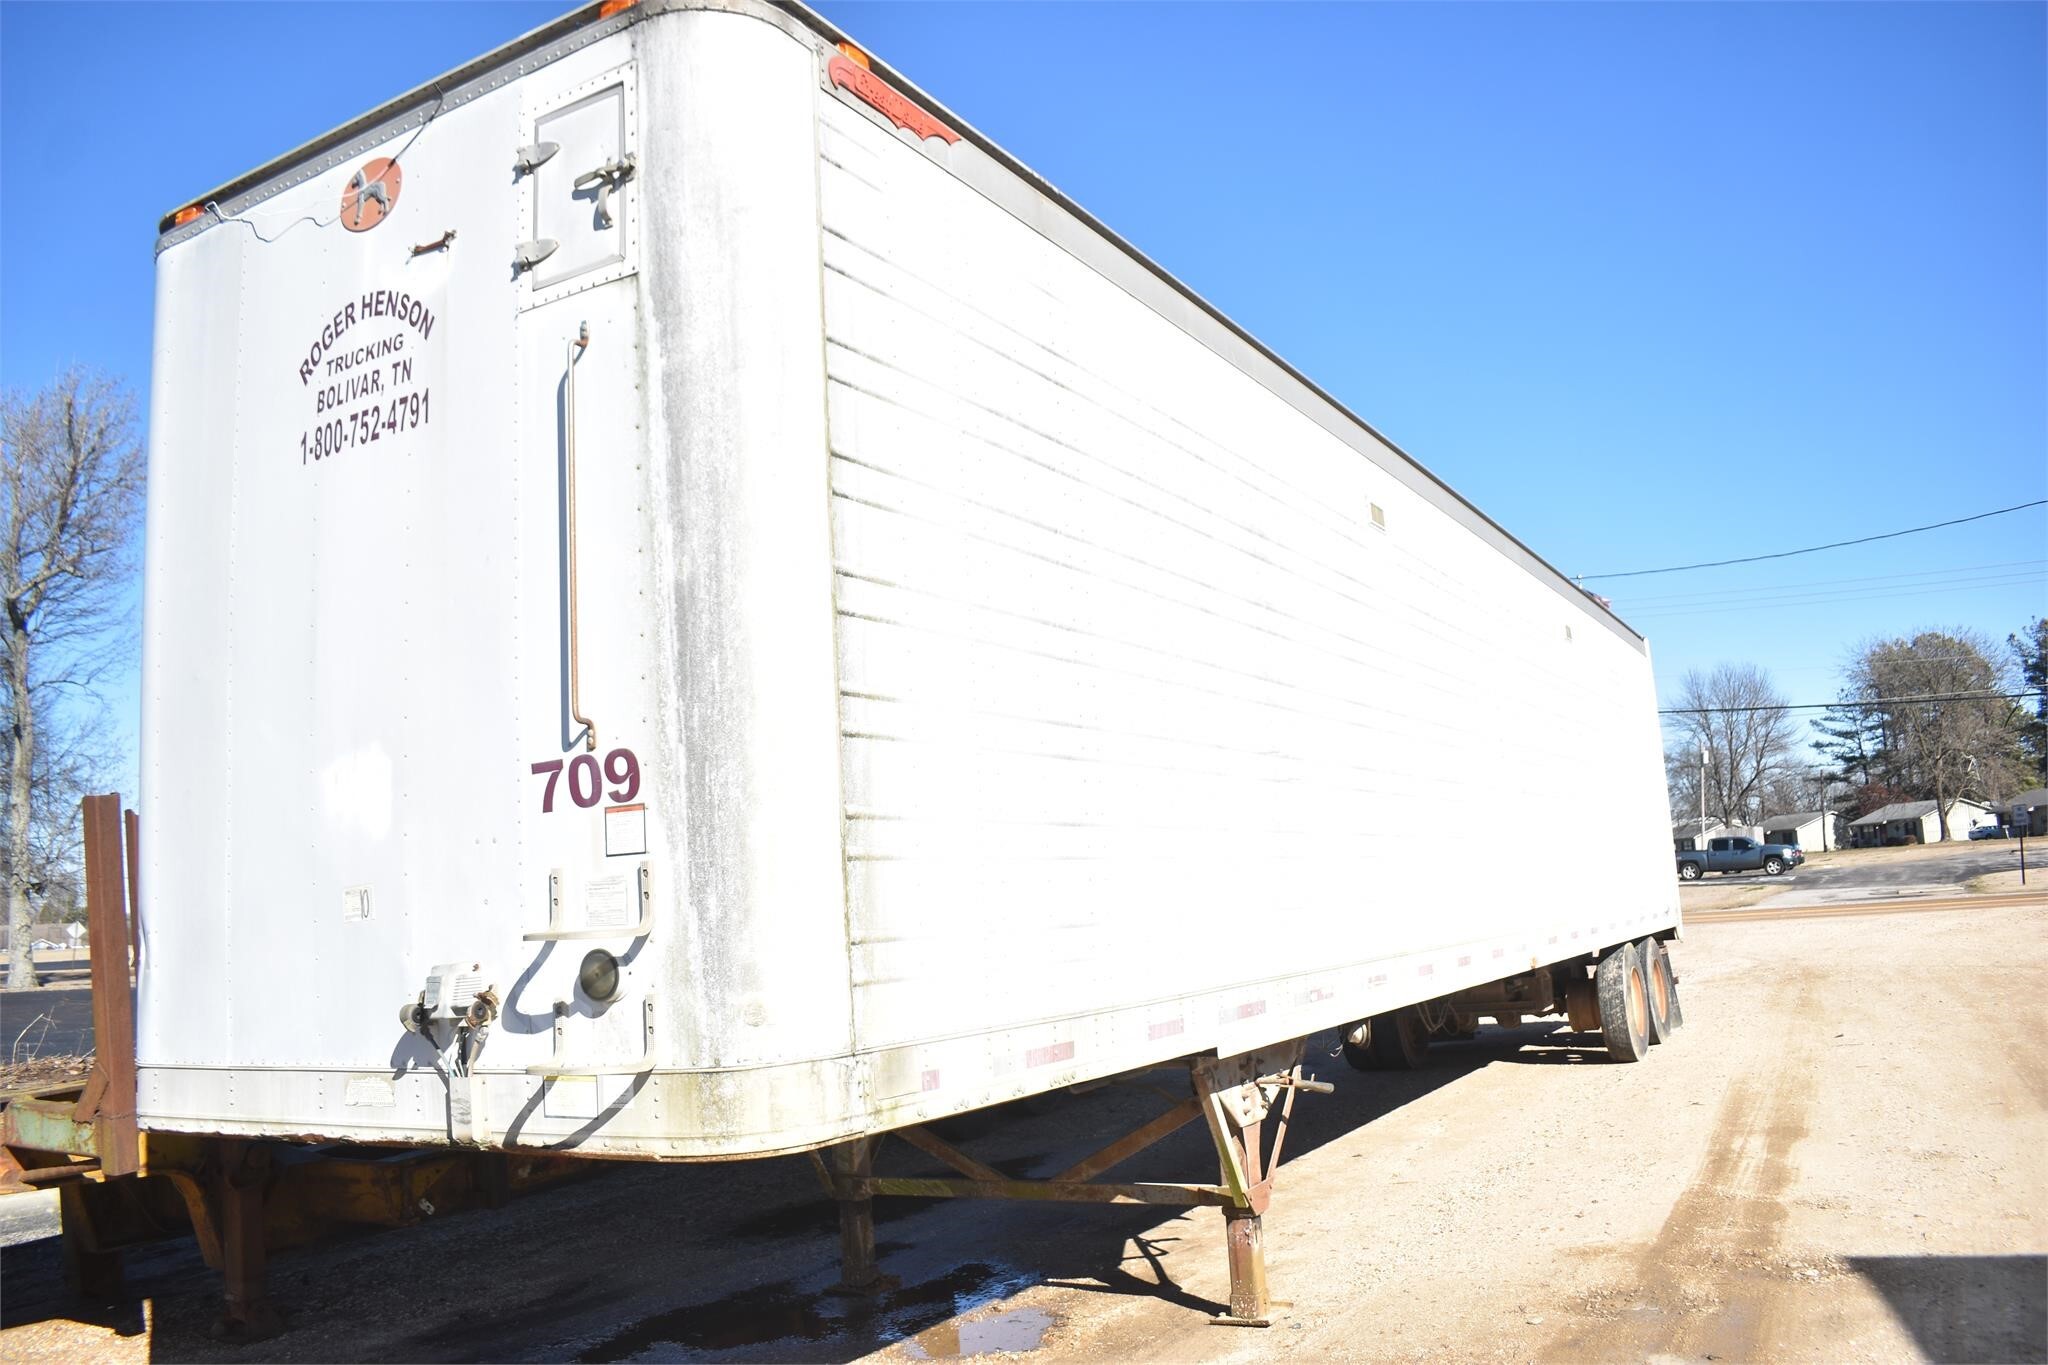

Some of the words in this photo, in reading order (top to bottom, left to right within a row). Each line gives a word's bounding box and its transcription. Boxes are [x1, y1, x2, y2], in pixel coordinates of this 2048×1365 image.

[299, 302, 356, 386] ROGER
[361, 290, 435, 340] HENSON
[326, 333, 404, 377] TRUCKING
[317, 369, 385, 413] BOLIVAR,
[392, 357, 412, 386] TN
[300, 387, 429, 465] 1-800-752-4791
[531, 748, 641, 813] 709
